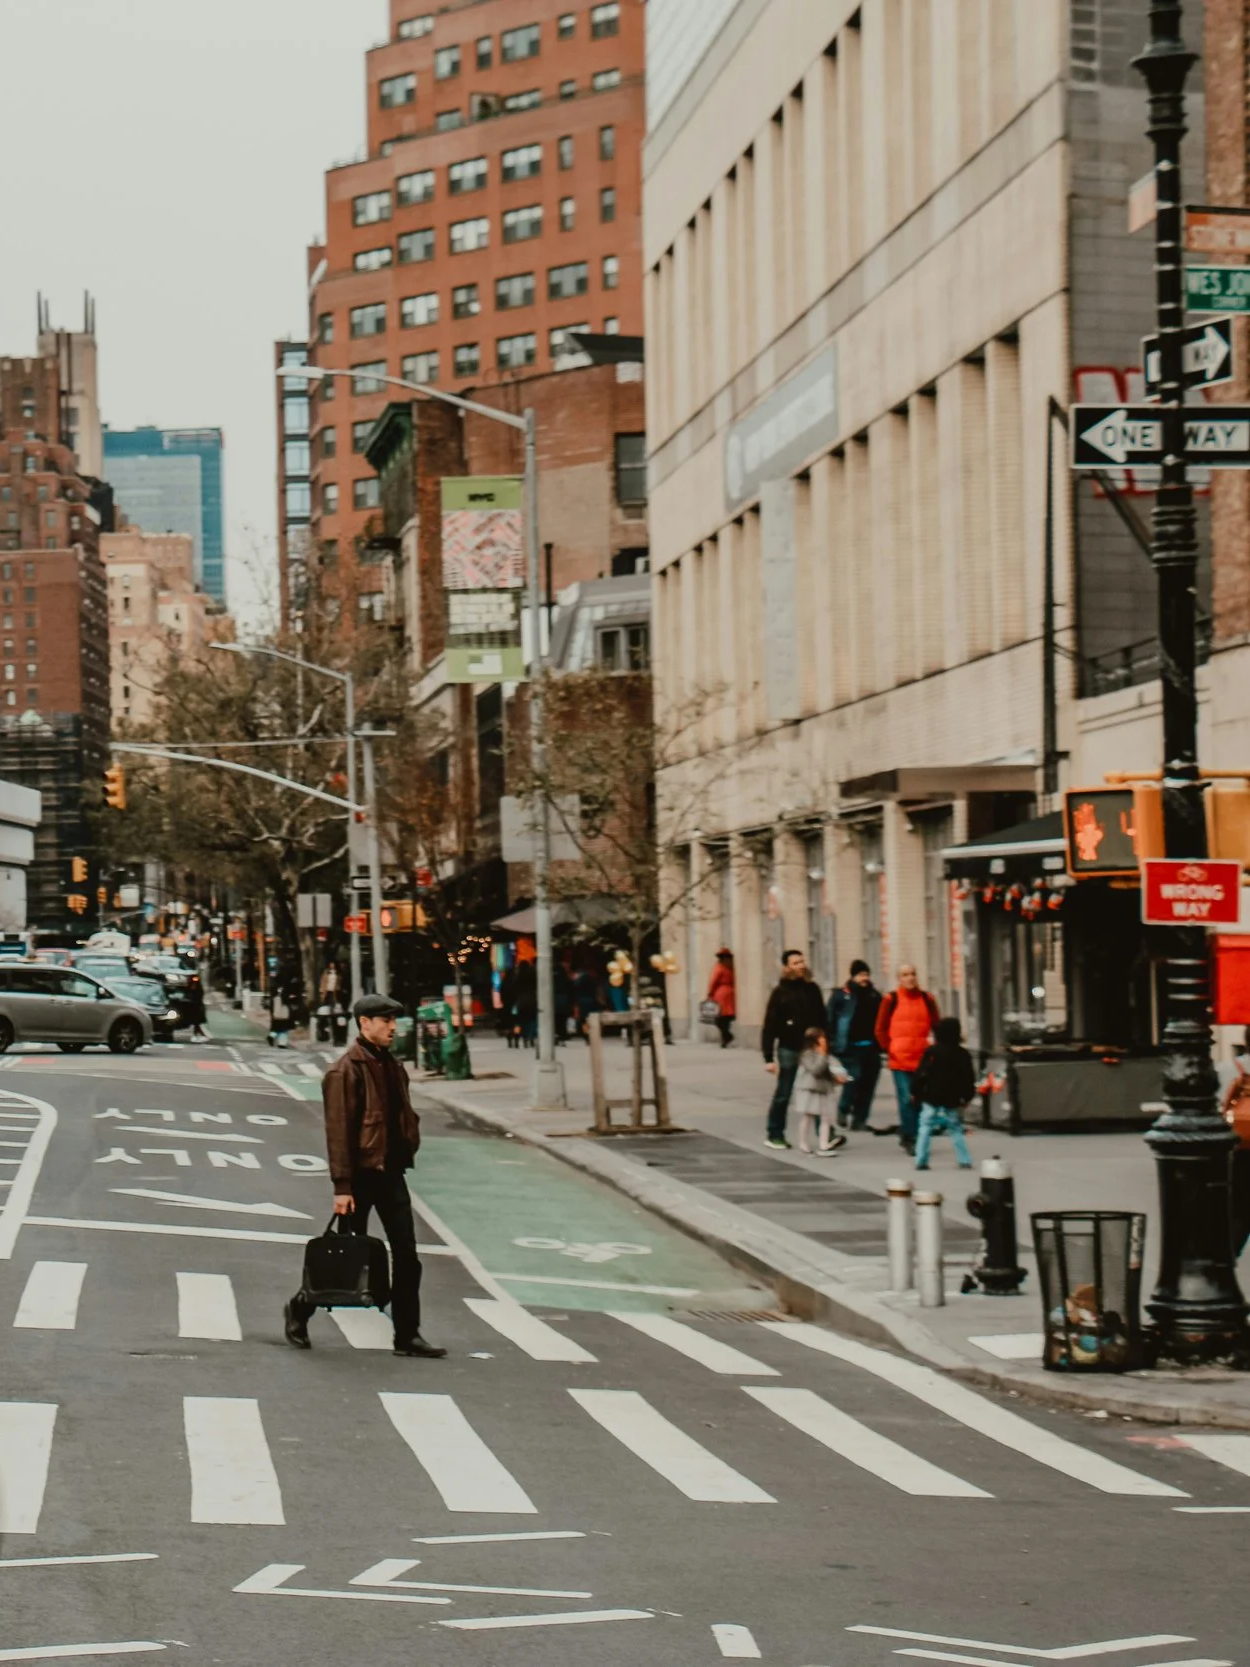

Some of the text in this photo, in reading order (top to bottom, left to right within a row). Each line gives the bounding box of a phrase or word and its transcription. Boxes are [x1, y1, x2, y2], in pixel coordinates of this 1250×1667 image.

[1187, 271, 1250, 296] WES JO
[1101, 425, 1238, 448] ONE WAY
[1160, 884, 1225, 900] WRONG
[1172, 901, 1211, 917] WAY
[93, 1108, 288, 1126] ONLY
[93, 1147, 330, 1172] ONLY
